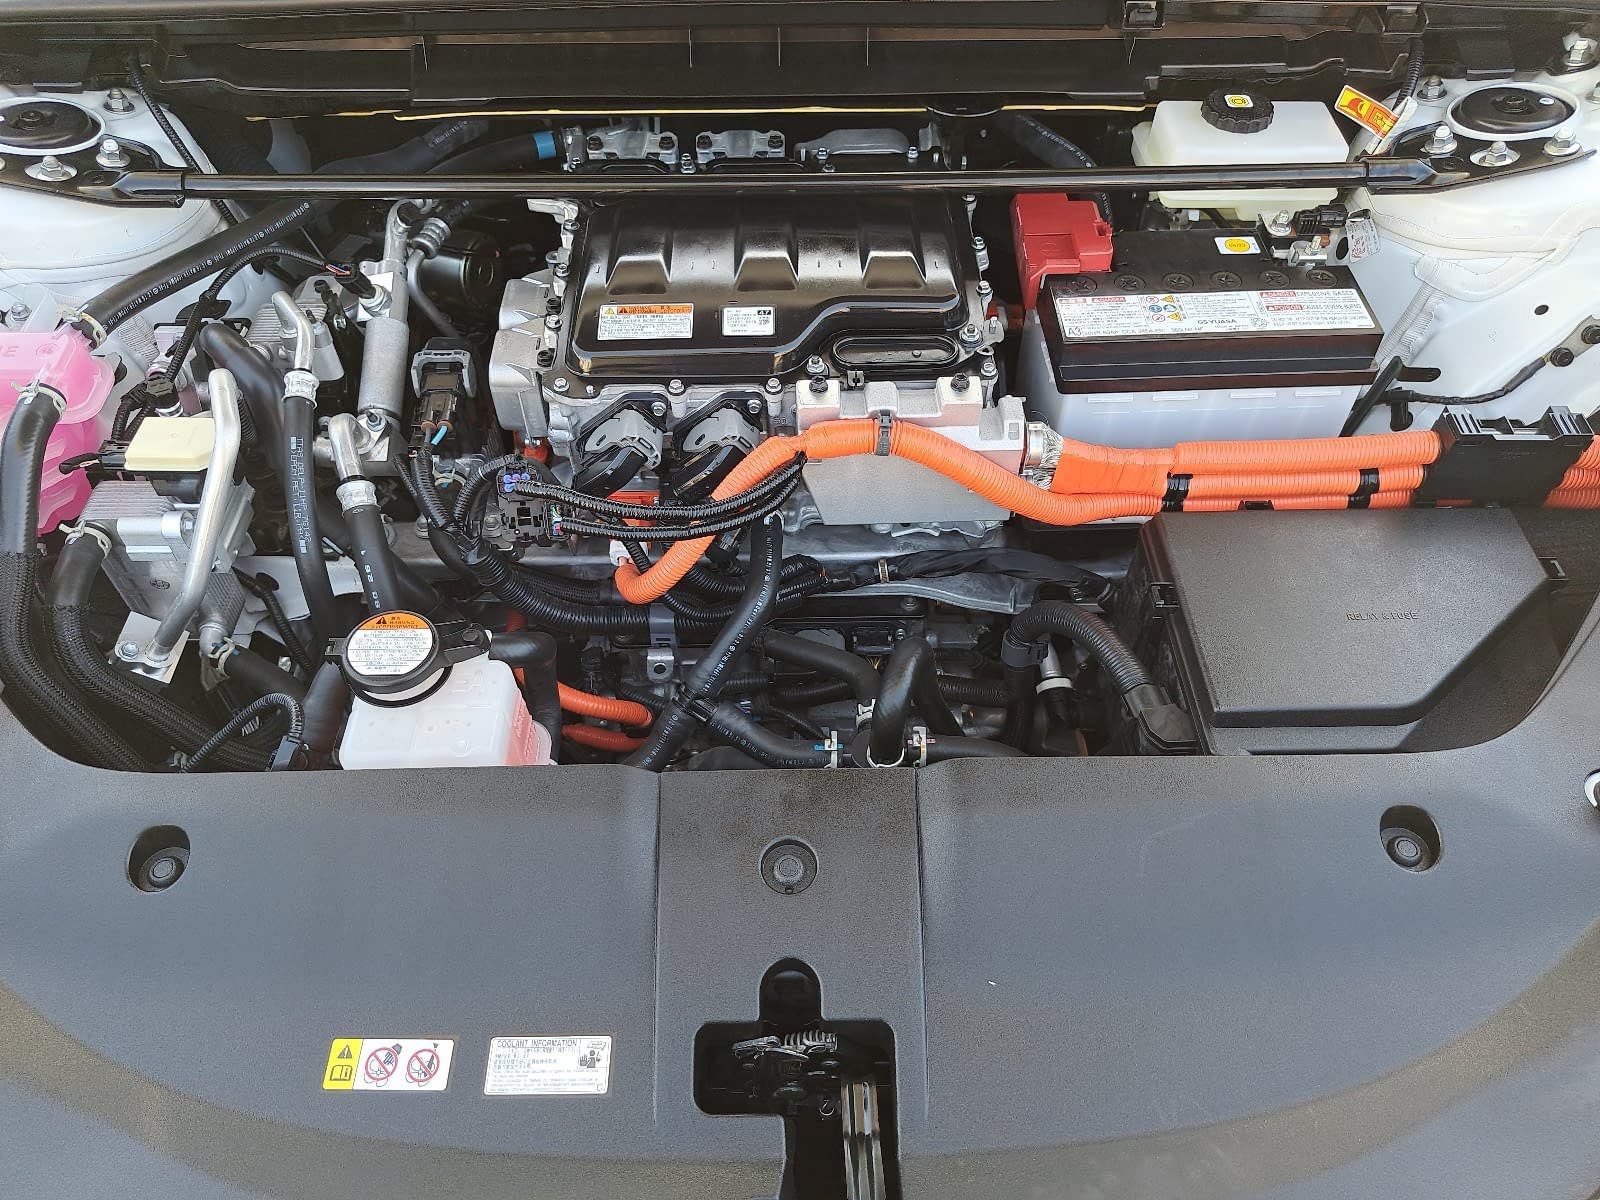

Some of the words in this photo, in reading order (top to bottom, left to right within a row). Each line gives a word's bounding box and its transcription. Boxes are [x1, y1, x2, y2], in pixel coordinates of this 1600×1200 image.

[1068, 327, 1081, 337] A3
[1346, 612, 1379, 621] RELAY
[1391, 611, 1420, 620] FUSE
[497, 1039, 528, 1048] COOLANT
[531, 1039, 578, 1048] INFORMATION
